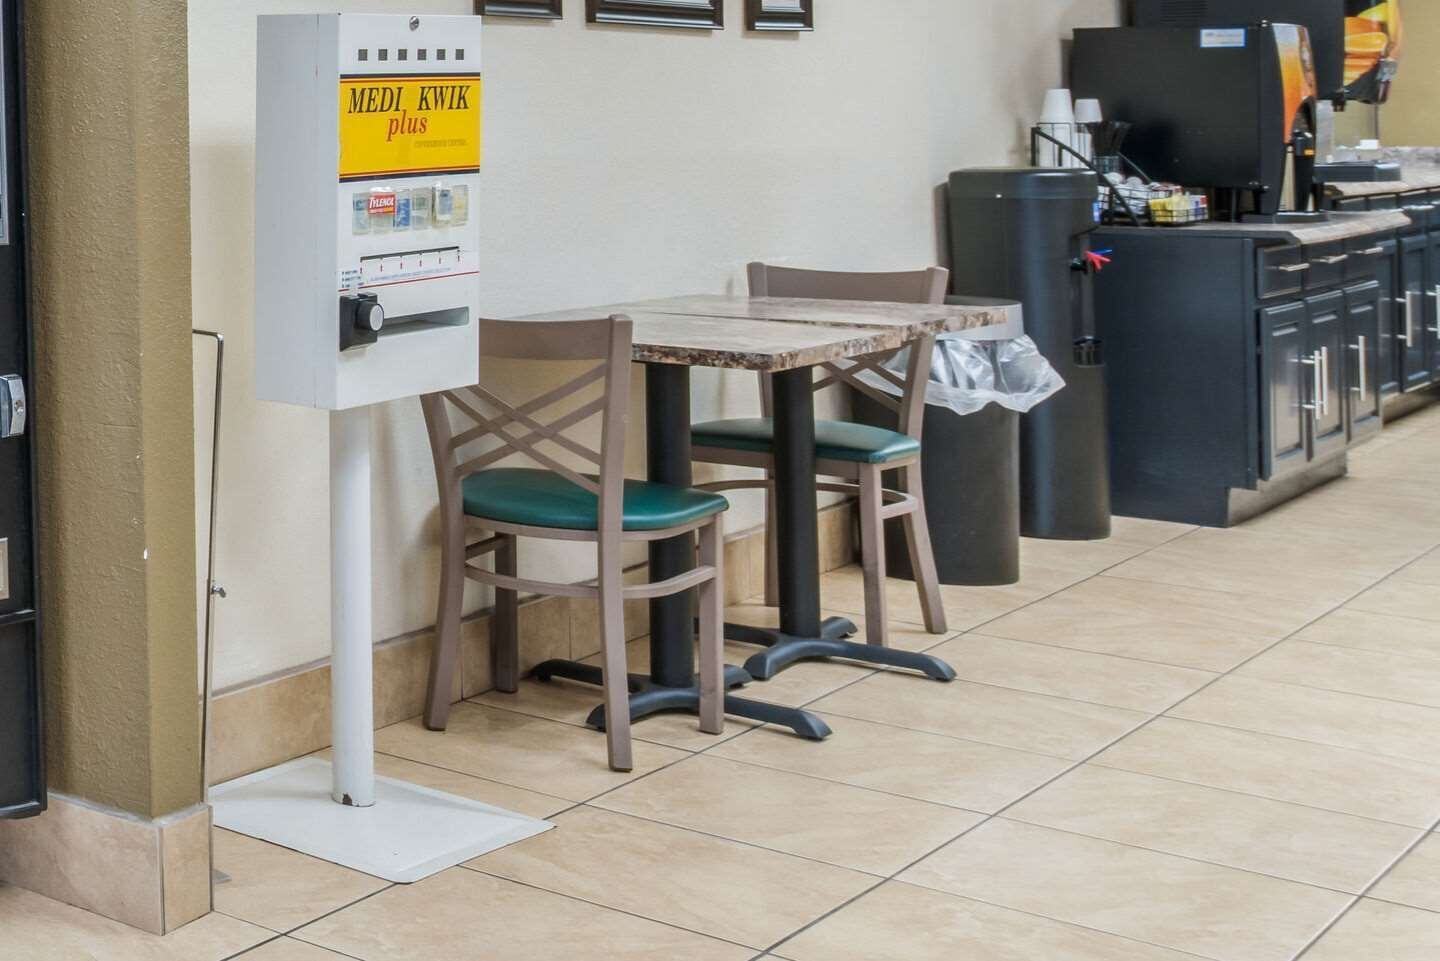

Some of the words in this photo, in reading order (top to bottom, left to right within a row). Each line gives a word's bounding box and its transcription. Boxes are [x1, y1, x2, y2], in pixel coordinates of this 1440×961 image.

[347, 87, 403, 114] MEDI
[416, 85, 471, 111] KWIK
[386, 110, 428, 141] plus
[369, 196, 394, 208] TYLENOL
